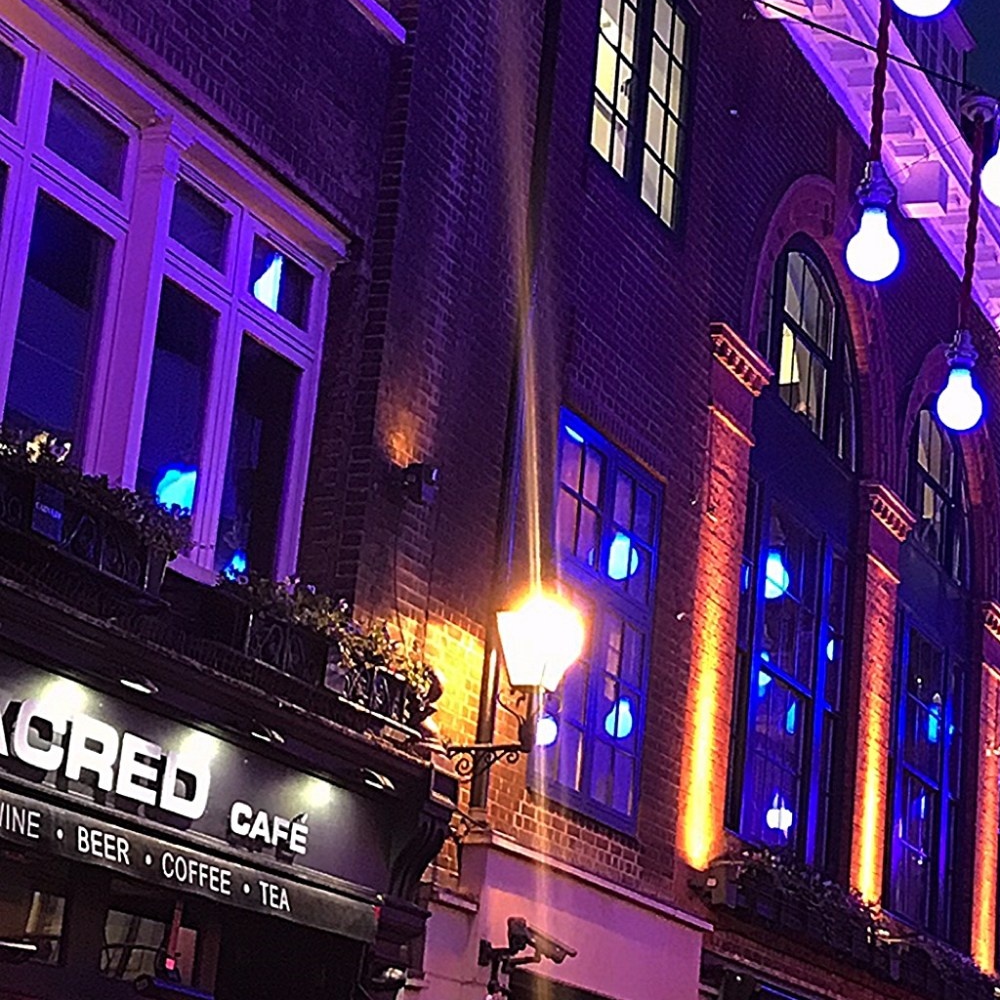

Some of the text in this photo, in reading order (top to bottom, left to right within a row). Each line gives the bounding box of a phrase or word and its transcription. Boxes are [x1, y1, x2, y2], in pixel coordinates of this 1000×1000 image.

[0, 801, 291, 912] INE BEER COFFEE TEA
[229, 801, 309, 854] CAFÉ
